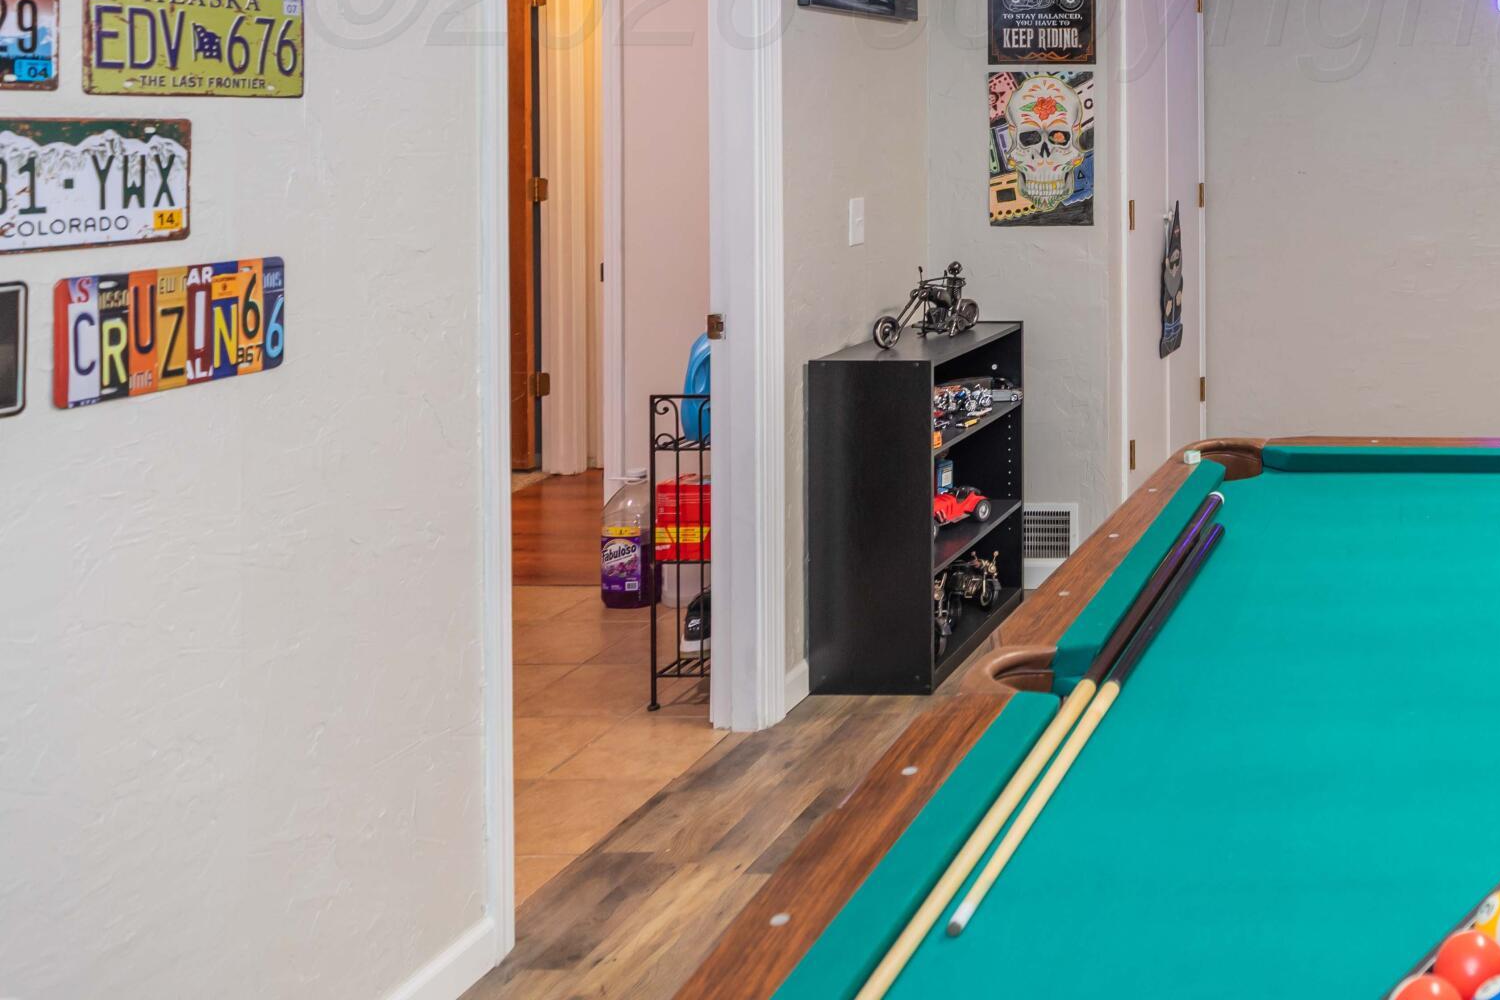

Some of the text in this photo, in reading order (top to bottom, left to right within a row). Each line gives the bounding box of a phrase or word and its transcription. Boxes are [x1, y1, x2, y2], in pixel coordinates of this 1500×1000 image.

[1037, 13, 1083, 21] BALANCED,
[95, 5, 298, 77] EDV 676
[1003, 28, 1082, 50] KEEP RIDING.
[27, 66, 49, 79] 04
[139, 75, 266, 89] THE LAST FRONTIER
[0, 215, 129, 238] COLORADO
[158, 213, 175, 226] 14
[602, 544, 637, 562] Fabuloso
